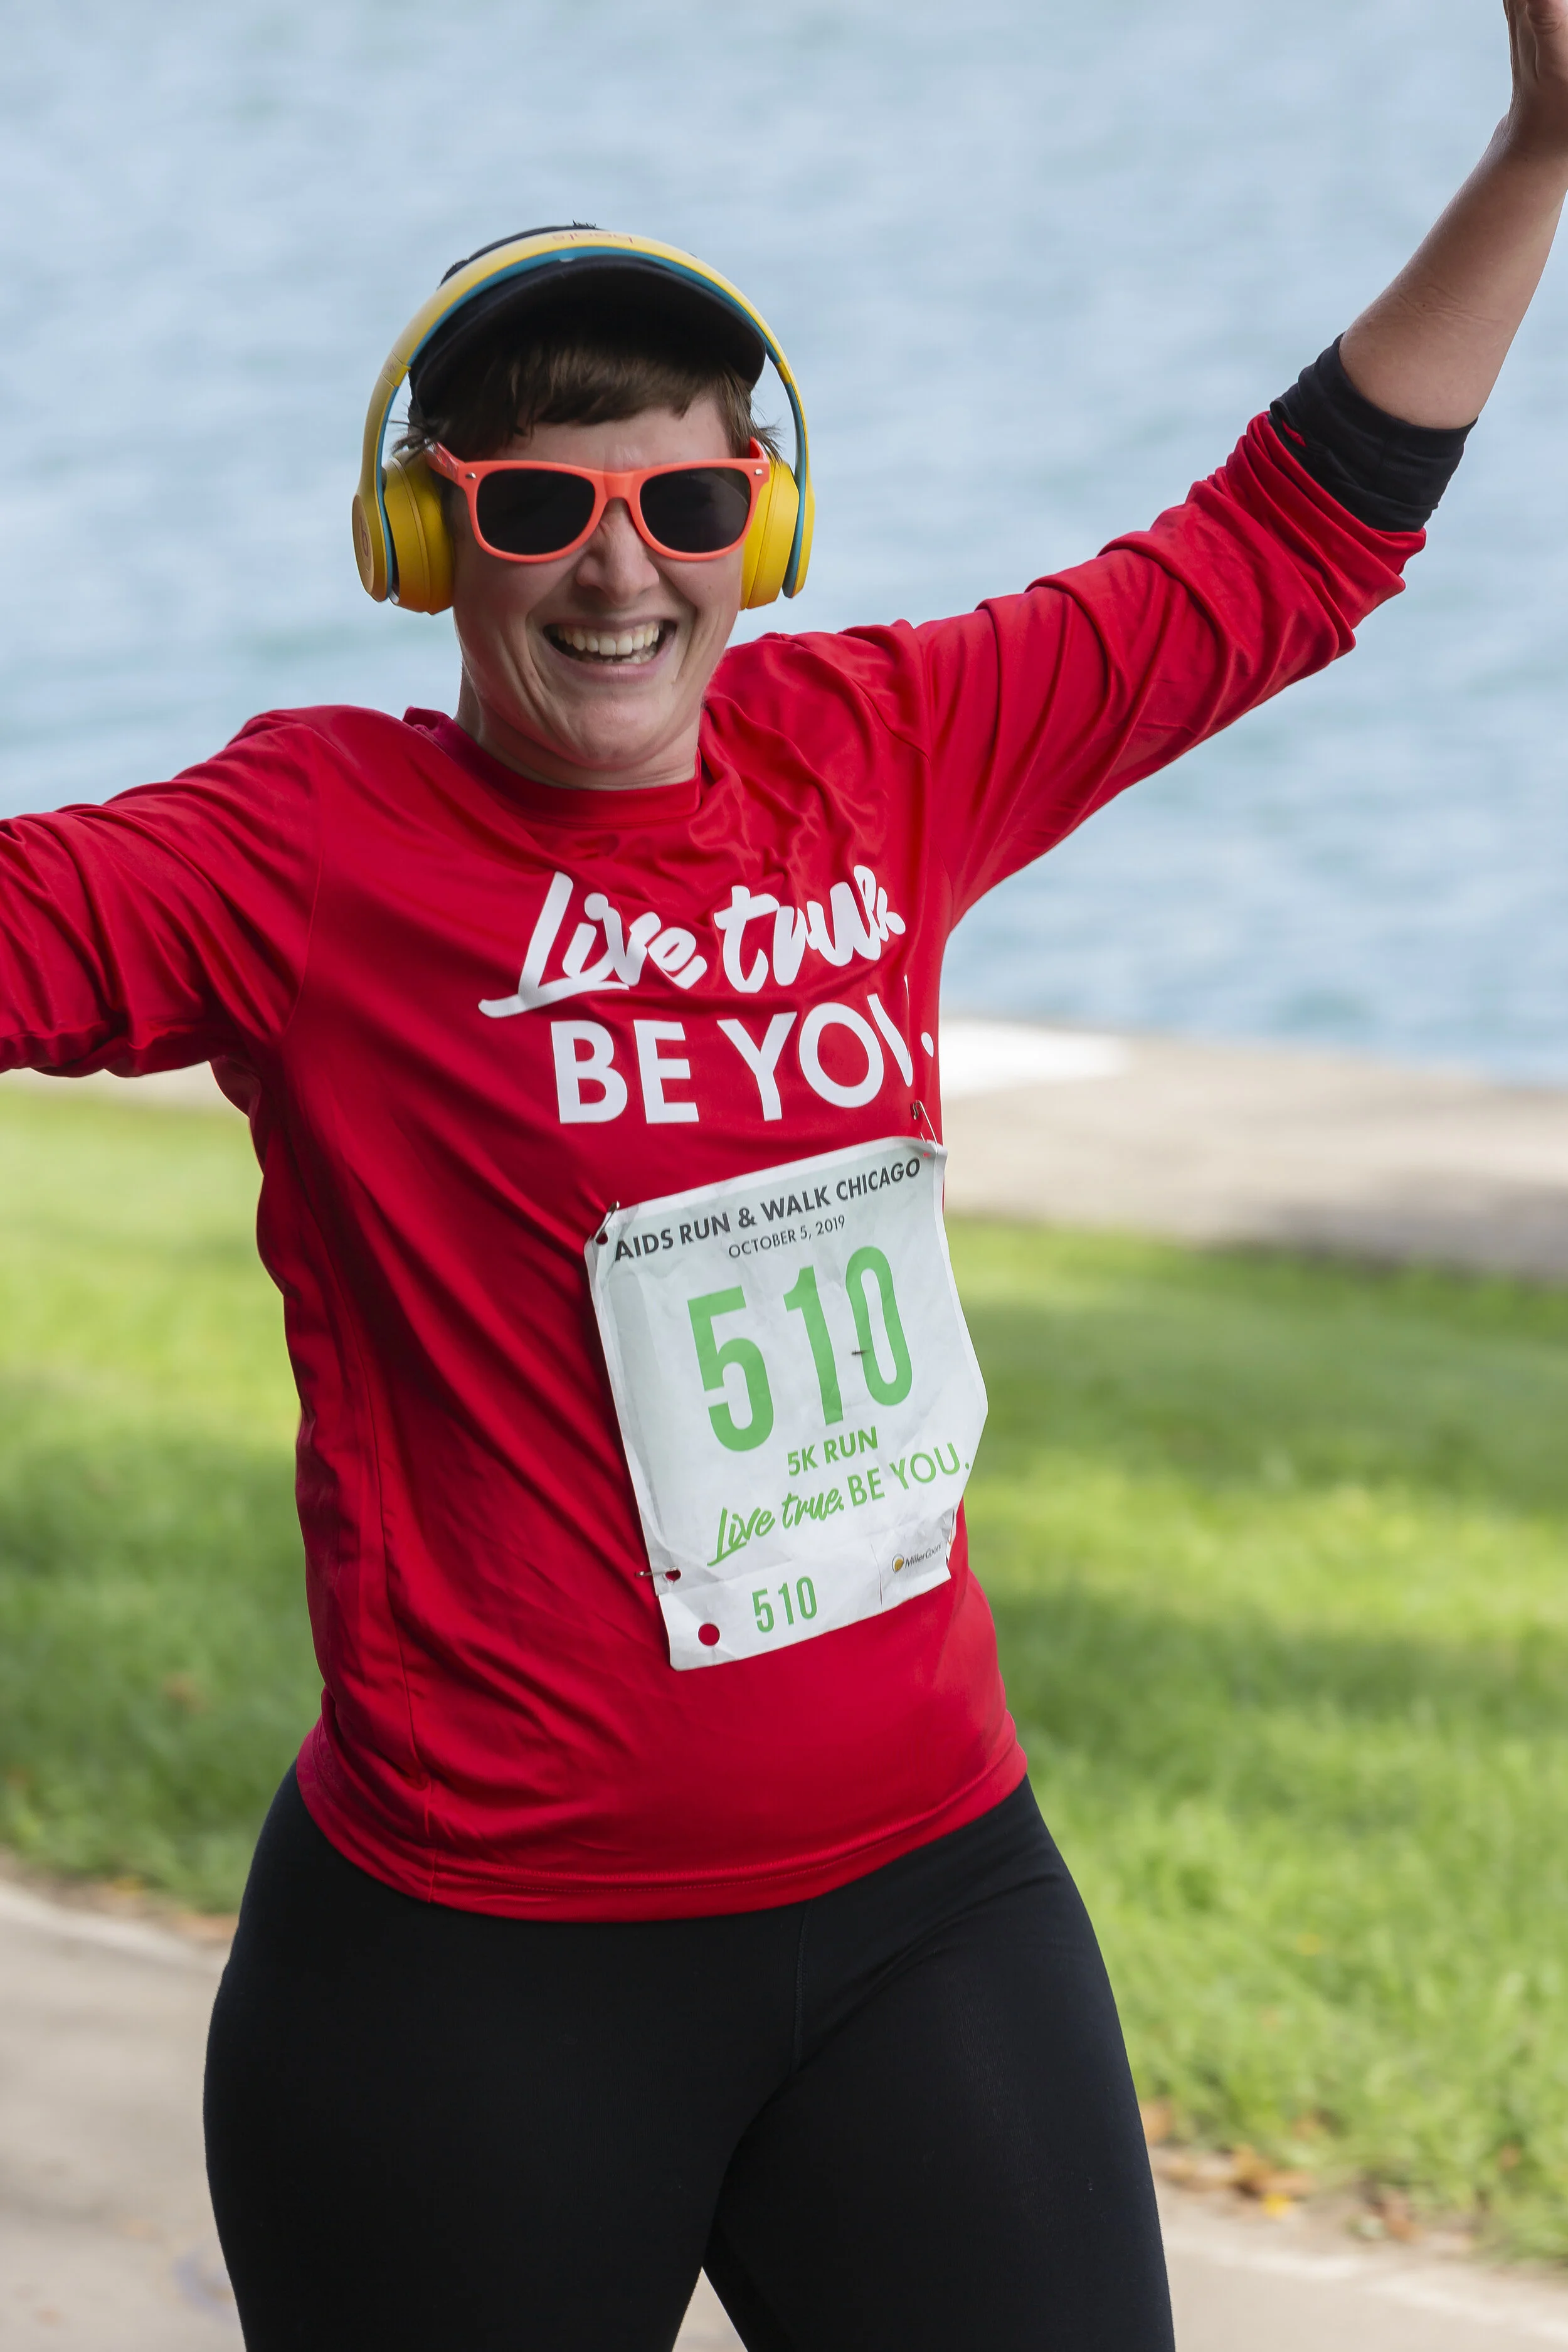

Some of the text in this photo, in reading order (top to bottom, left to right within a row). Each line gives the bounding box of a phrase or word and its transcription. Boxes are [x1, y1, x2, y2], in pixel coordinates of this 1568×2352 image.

[478, 871, 708, 1018] Live
[551, 1019, 699, 1124] BE
[614, 1157, 920, 1262] AIDS RUN & WALK CHICAGO
[728, 1214, 845, 1258] OCTOBER 5, 2019
[687, 1246, 913, 1453] 510
[787, 1426, 878, 1476] 5K RUN
[707, 1442, 971, 1567] Live true. BE YOU.
[752, 1576, 817, 1633] 510
